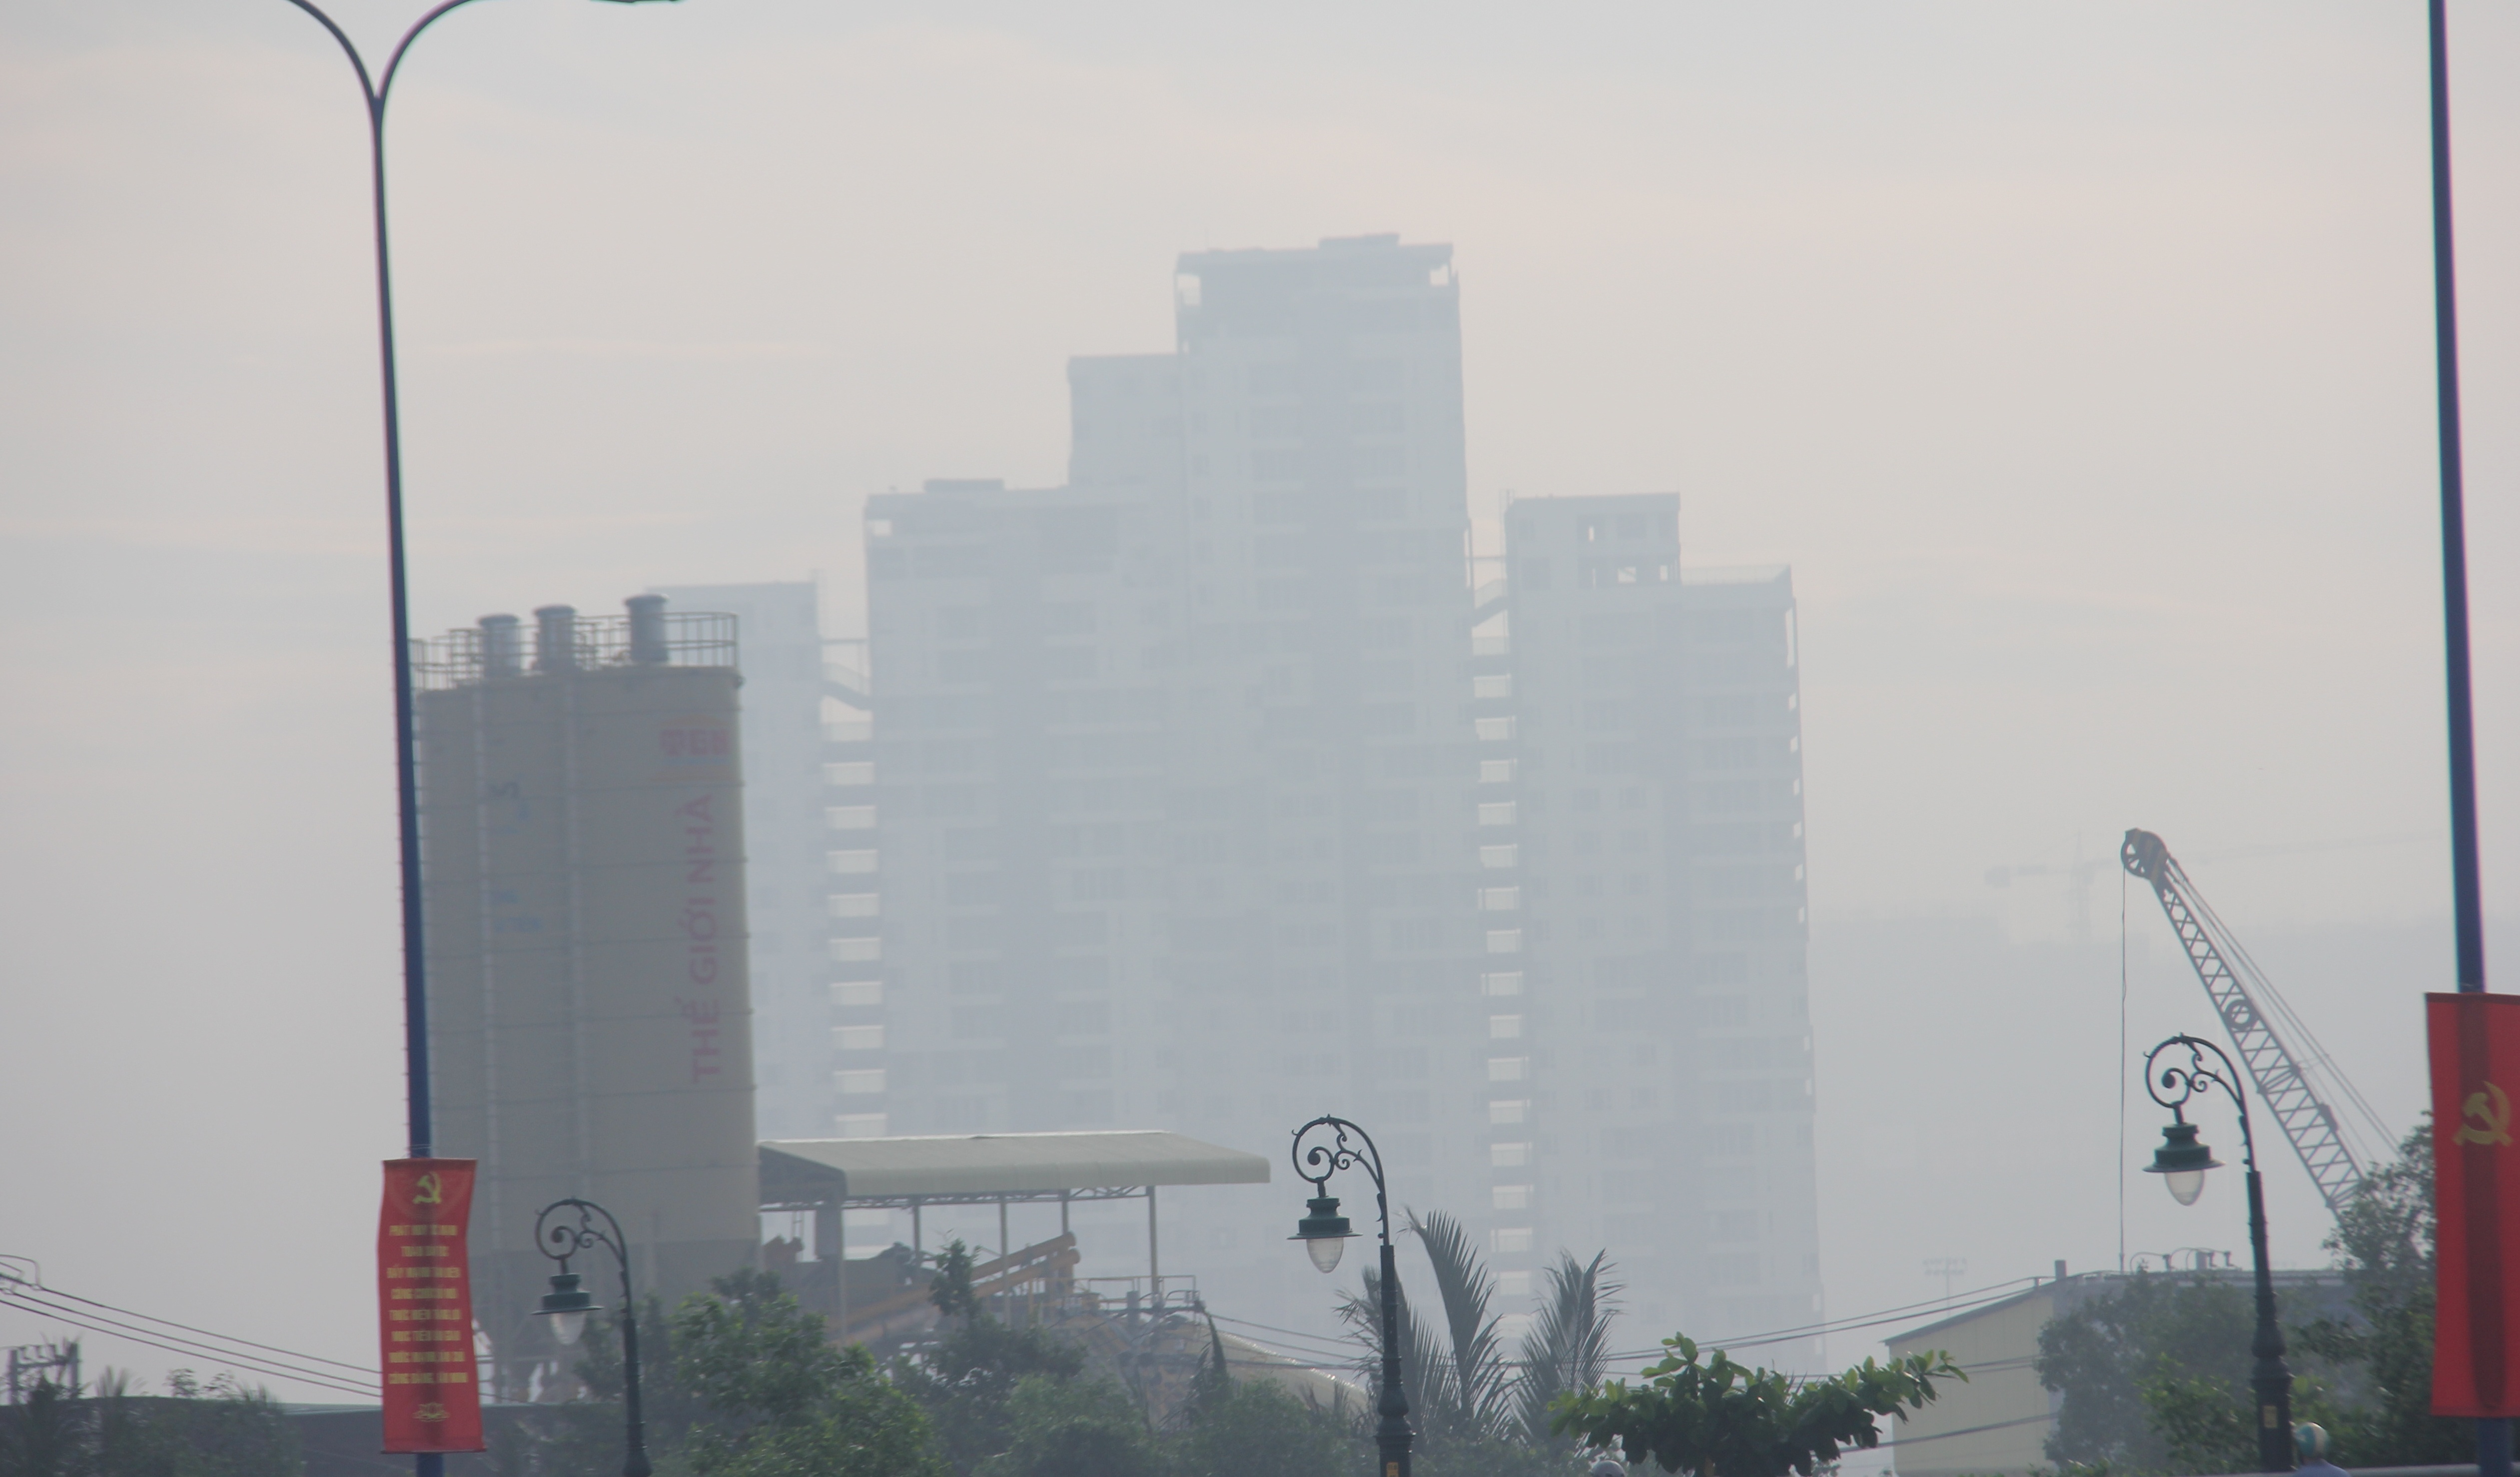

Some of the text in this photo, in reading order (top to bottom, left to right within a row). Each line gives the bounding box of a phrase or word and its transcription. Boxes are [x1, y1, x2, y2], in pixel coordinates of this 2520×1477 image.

[674, 794, 715, 883] NHÀ
[678, 896, 718, 985] GIỚI
[674, 995, 723, 1084] THẾ
